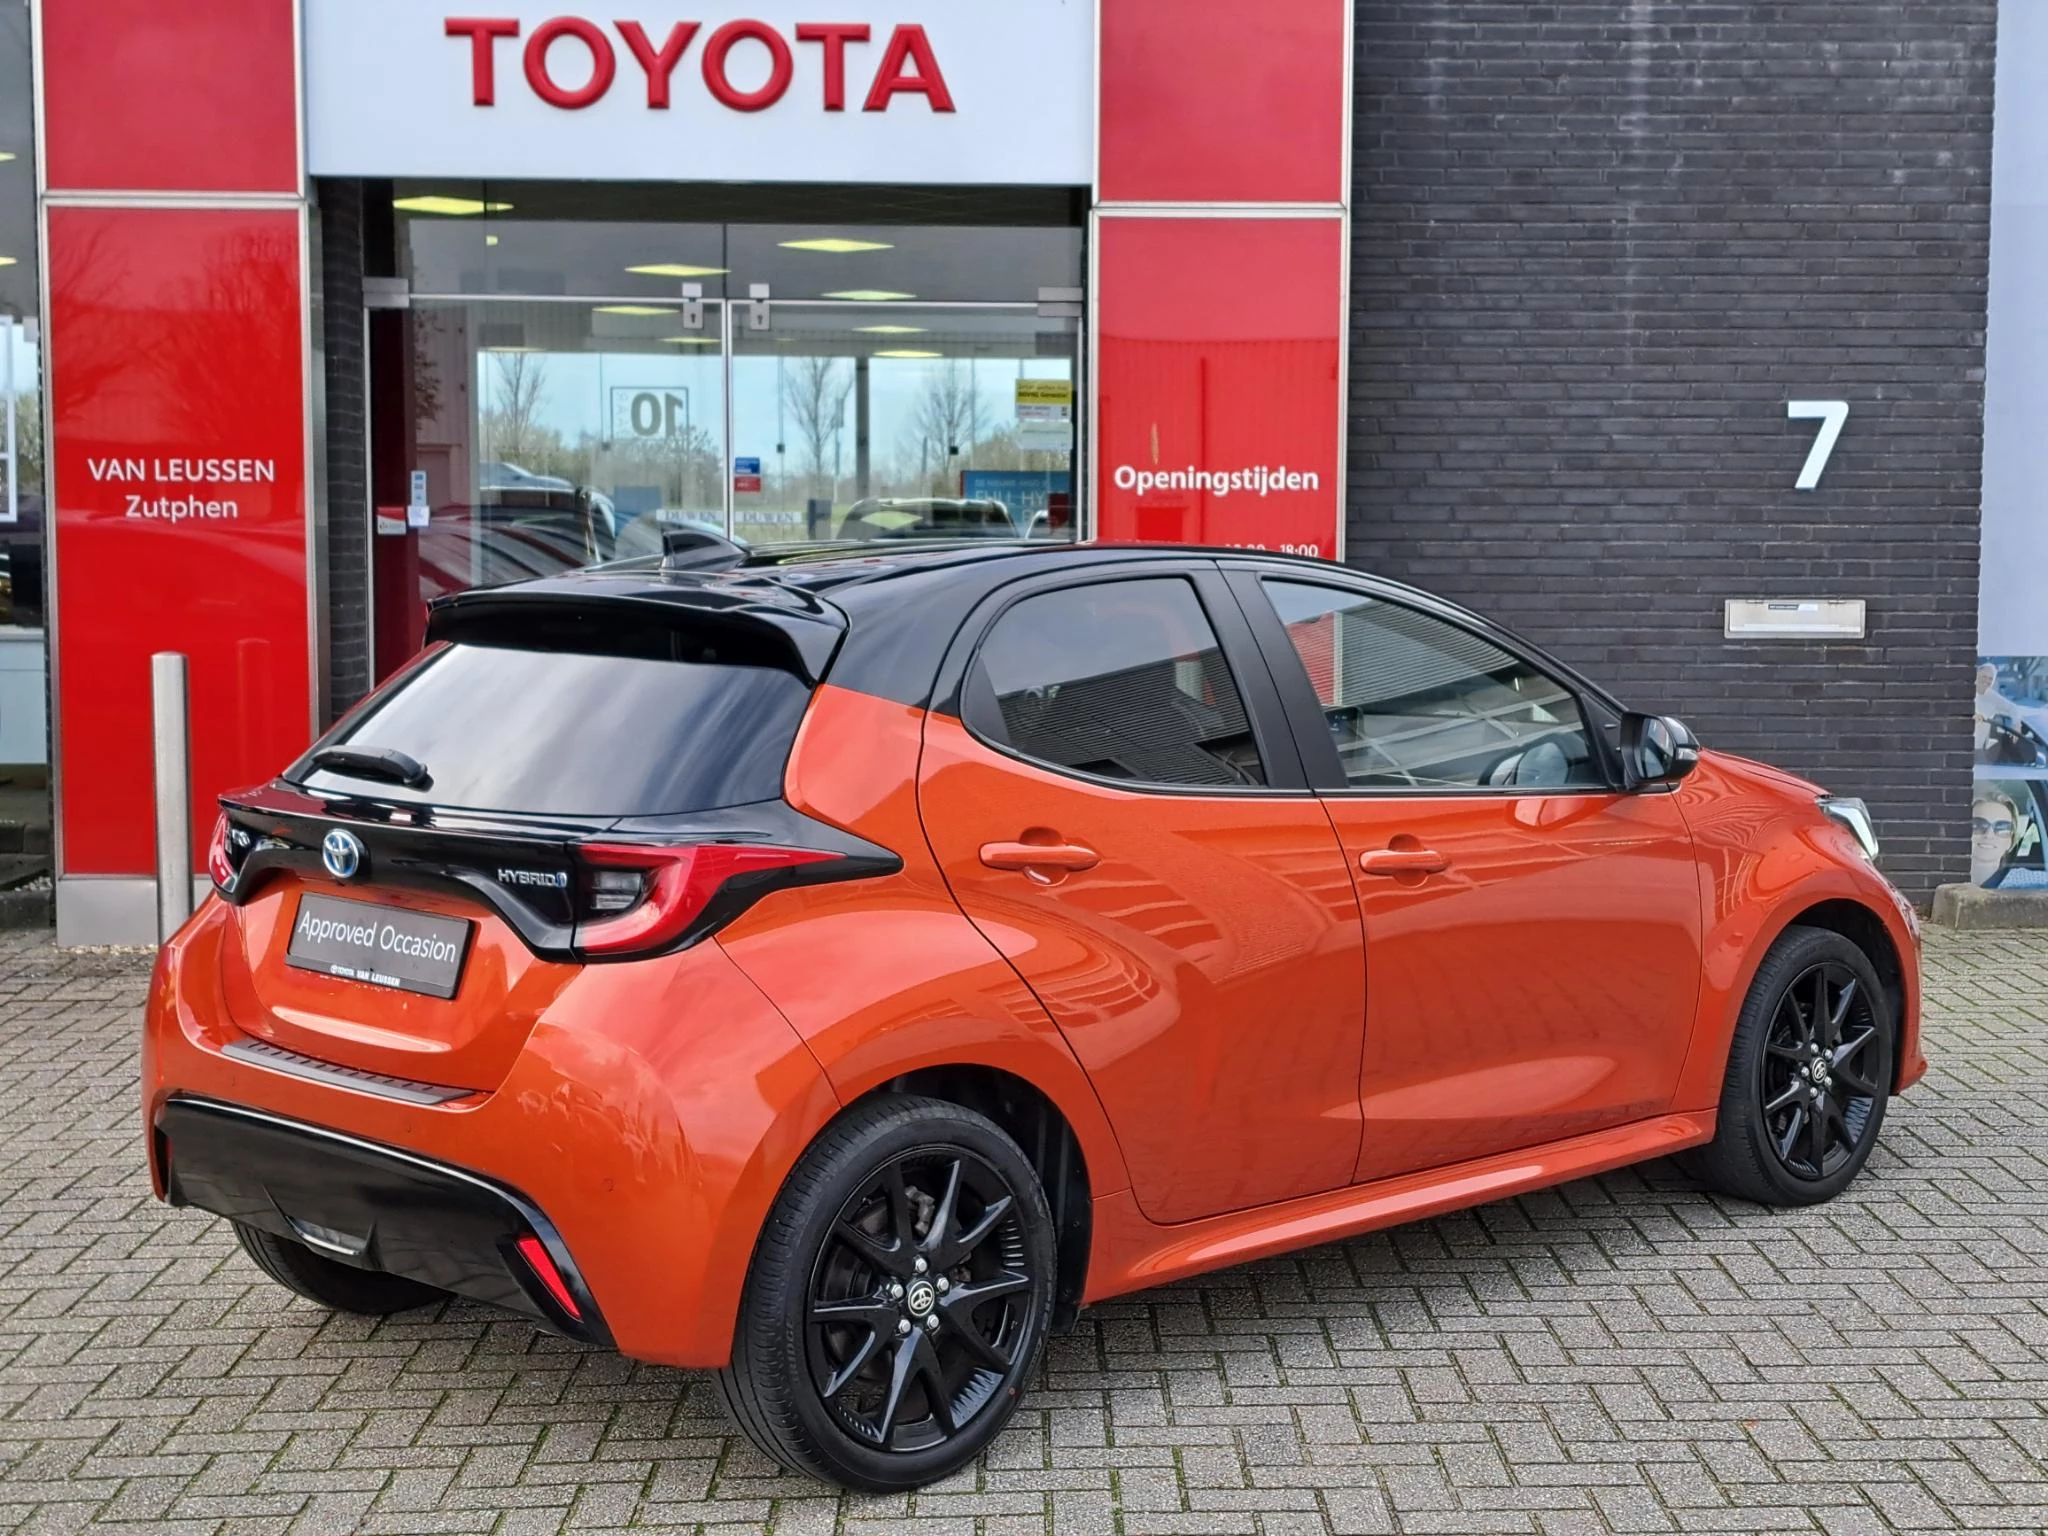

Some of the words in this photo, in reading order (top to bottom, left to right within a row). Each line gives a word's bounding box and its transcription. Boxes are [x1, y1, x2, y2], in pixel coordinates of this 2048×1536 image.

[445, 18, 955, 112] TOYOTA
[1788, 400, 1849, 489] 7
[88, 458, 145, 482] VAN
[154, 458, 275, 482] LEUSSEN
[1114, 465, 1319, 496] Openingstijden
[125, 494, 239, 523] Zutphen
[497, 868, 556, 887] HYBRID
[298, 910, 377, 947] Approved
[380, 925, 457, 963] Occasion
[357, 969, 370, 980] VAN
[371, 972, 401, 987] LEUSSEN
